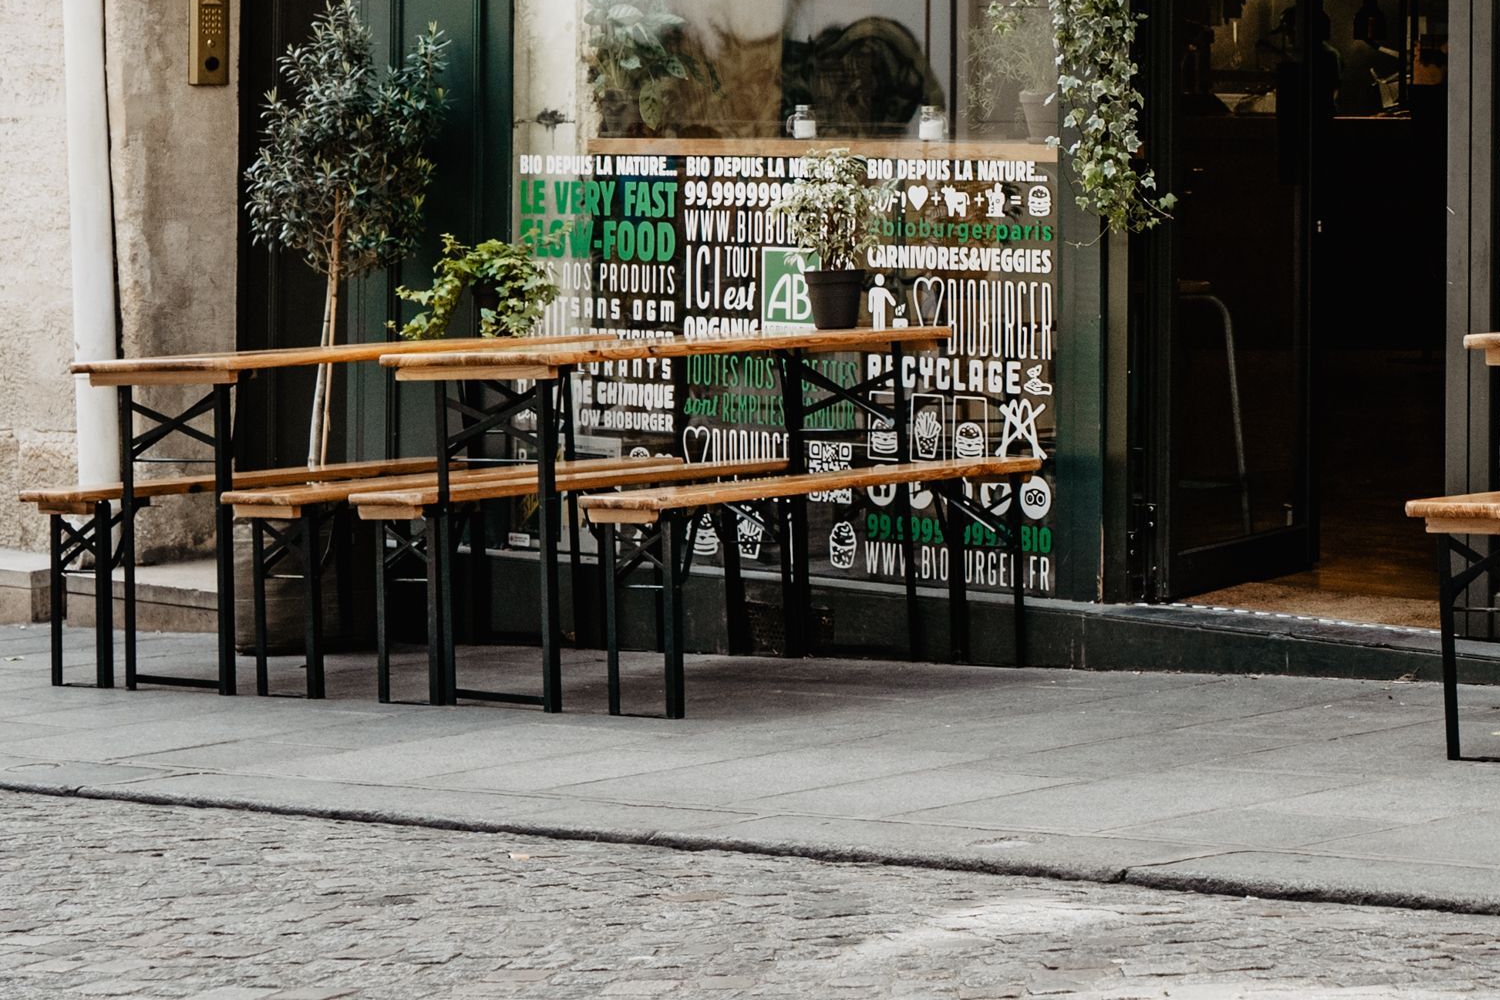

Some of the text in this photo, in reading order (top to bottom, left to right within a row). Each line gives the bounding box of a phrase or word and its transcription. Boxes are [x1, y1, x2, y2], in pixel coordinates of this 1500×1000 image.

[519, 154, 678, 177] BIO DEPUIS LA NATURE...
[686, 156, 710, 177] BIO
[713, 156, 764, 178] DEPUIS
[767, 157, 785, 178] LA
[867, 158, 1048, 182] BIO DEPUIS LA NATURE...
[520, 180, 678, 218] LE VERY FAST
[867, 244, 1053, 274] CARNIVORES&VEGGIES
[600, 264, 676, 294] PRODUITS
[685, 244, 758, 310] ICI TOUT
[723, 281, 756, 311] est
[767, 273, 811, 321] AB
[946, 278, 1053, 361] BIOBURGER
[686, 354, 740, 388] TOUTES
[604, 411, 674, 433] BIOBURGER
[683, 395, 719, 416] sont
[722, 392, 785, 426] REMPLIES
[1021, 525, 1052, 554] BIO
